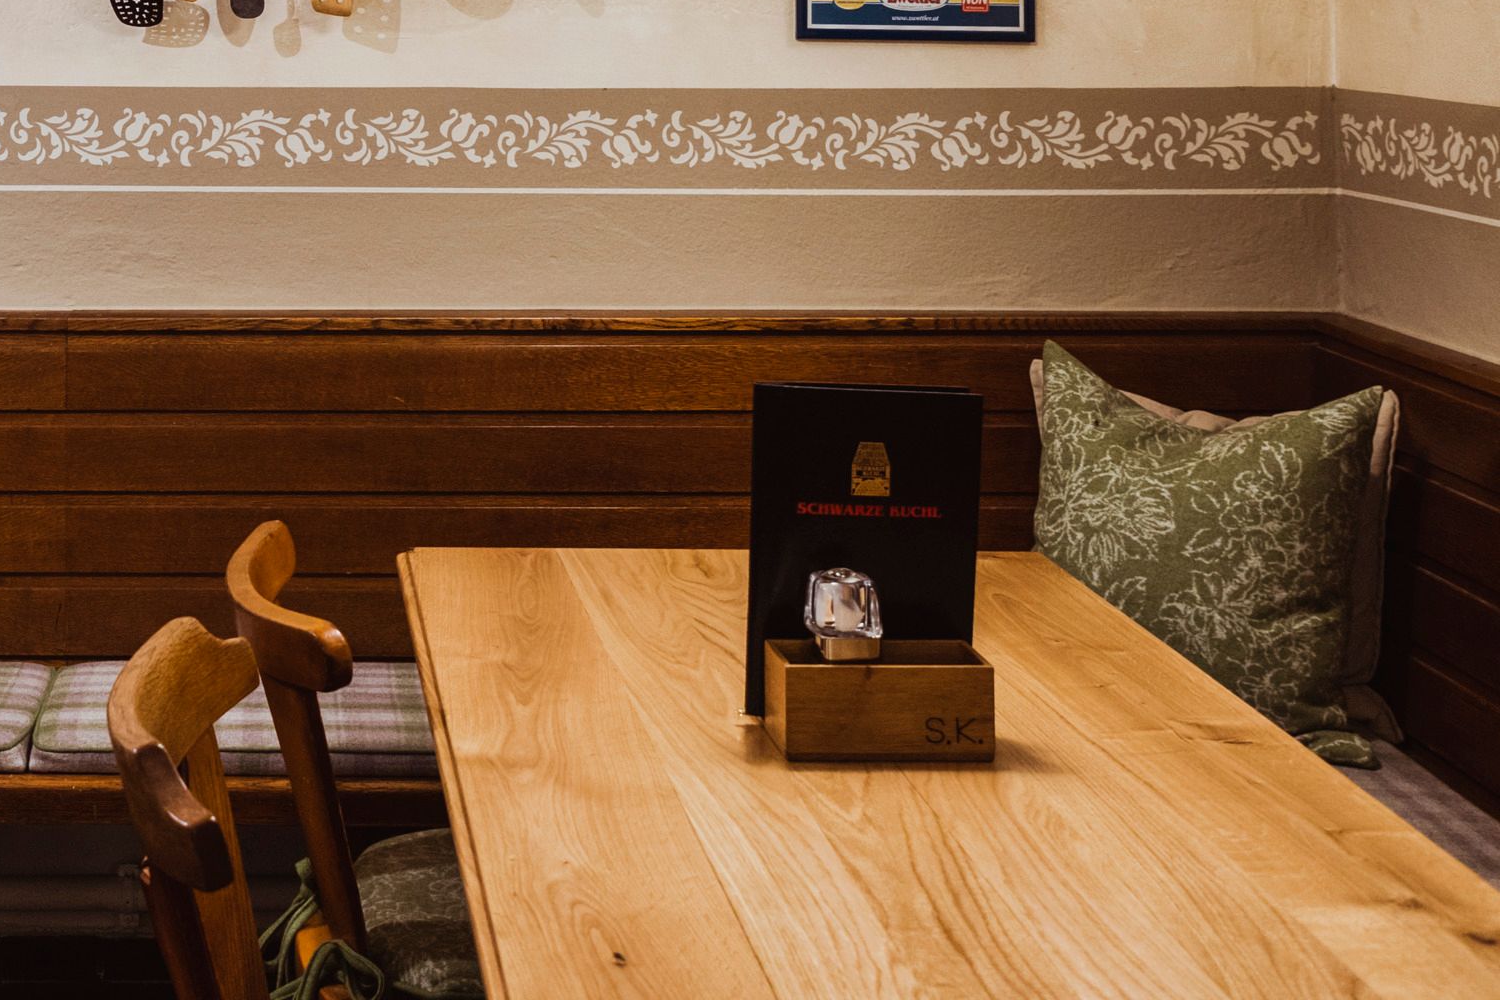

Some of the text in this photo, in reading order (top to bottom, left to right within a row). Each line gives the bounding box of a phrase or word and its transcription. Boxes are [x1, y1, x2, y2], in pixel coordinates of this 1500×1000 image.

[797, 501, 942, 519] SCHWARZE KUCHL
[924, 716, 984, 745] S.K.
